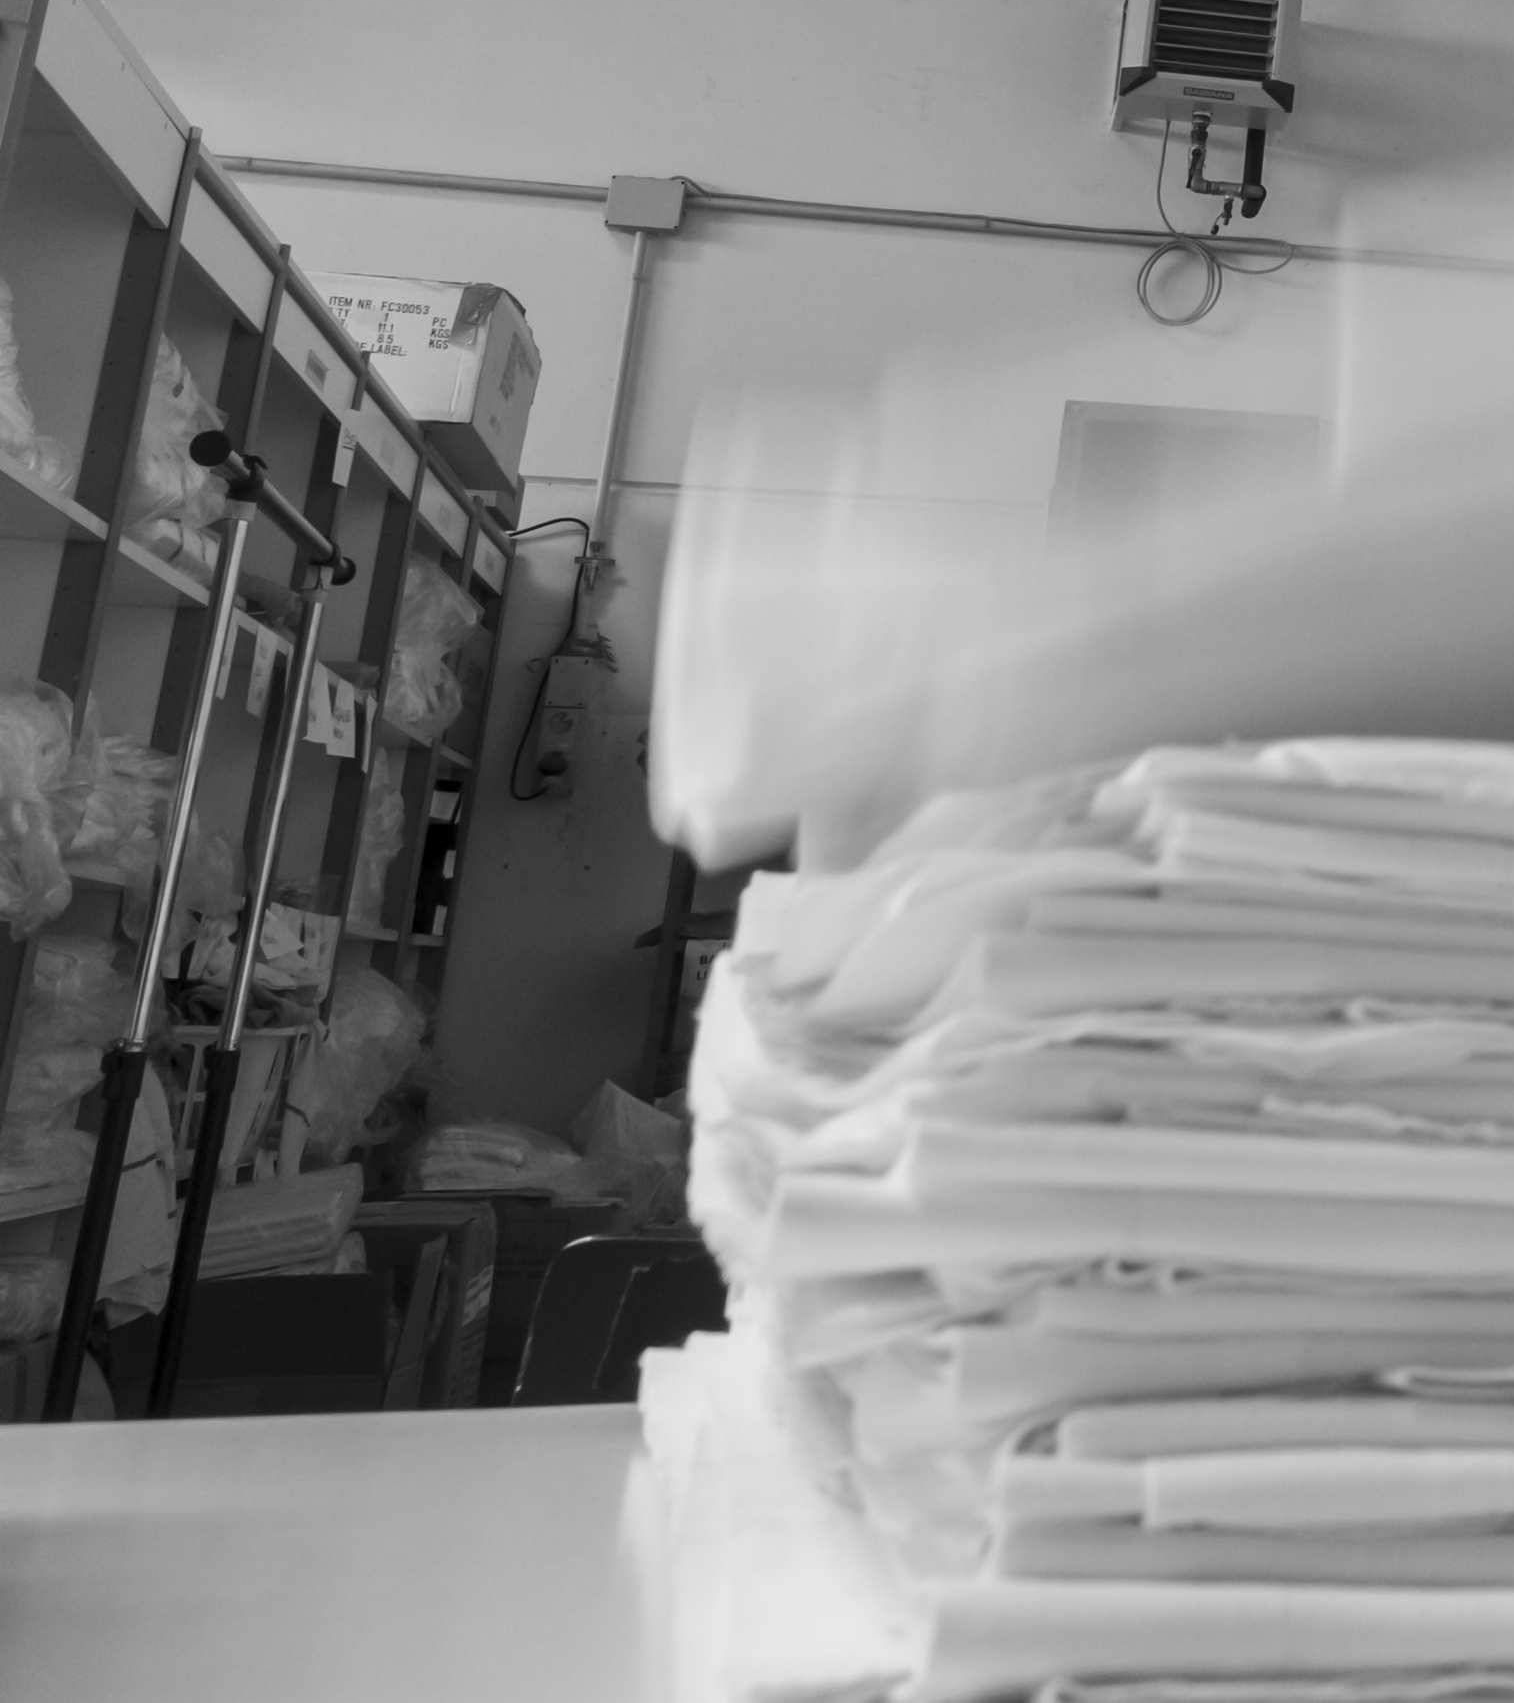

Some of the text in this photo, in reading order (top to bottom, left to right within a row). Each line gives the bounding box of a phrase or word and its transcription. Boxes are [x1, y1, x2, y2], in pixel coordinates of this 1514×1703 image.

[329, 296, 353, 307] ITEM
[430, 328, 450, 338] KGS
[428, 339, 449, 350] KGS
